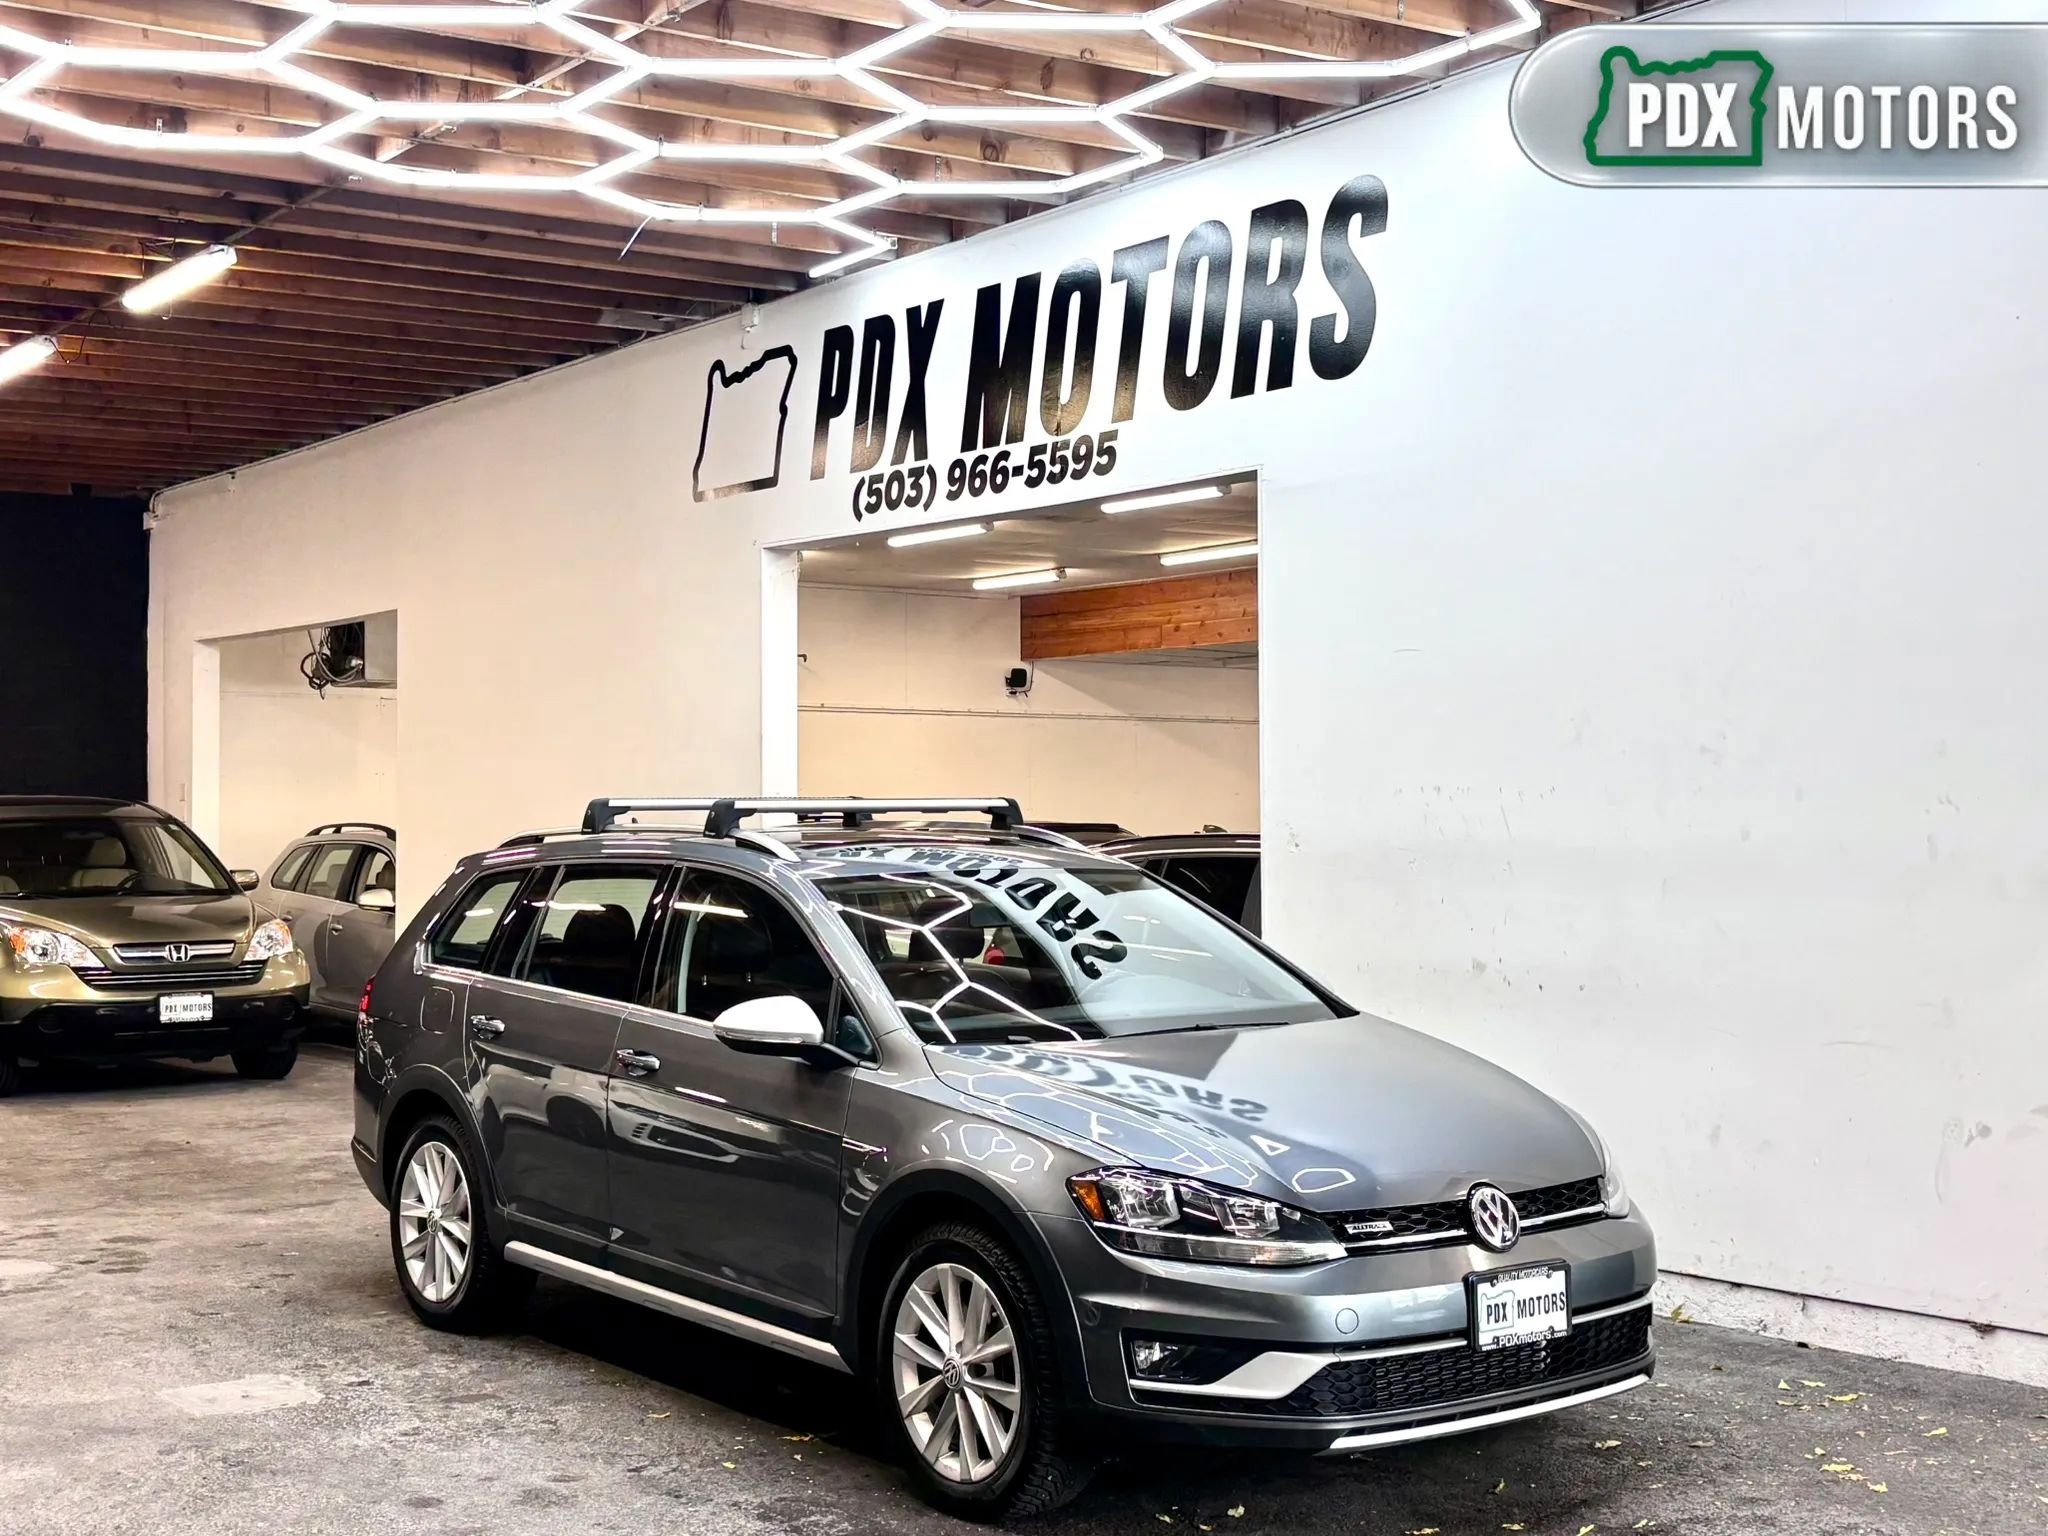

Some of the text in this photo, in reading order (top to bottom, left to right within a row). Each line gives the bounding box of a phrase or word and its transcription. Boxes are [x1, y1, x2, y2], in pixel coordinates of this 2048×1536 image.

[810, 174, 1390, 481] PDX MOTORS
[852, 430, 1118, 523] (503) 966-5595
[182, 1002, 212, 1012] MOTORS
[1486, 1291, 1566, 1325] PDX MOTORS
